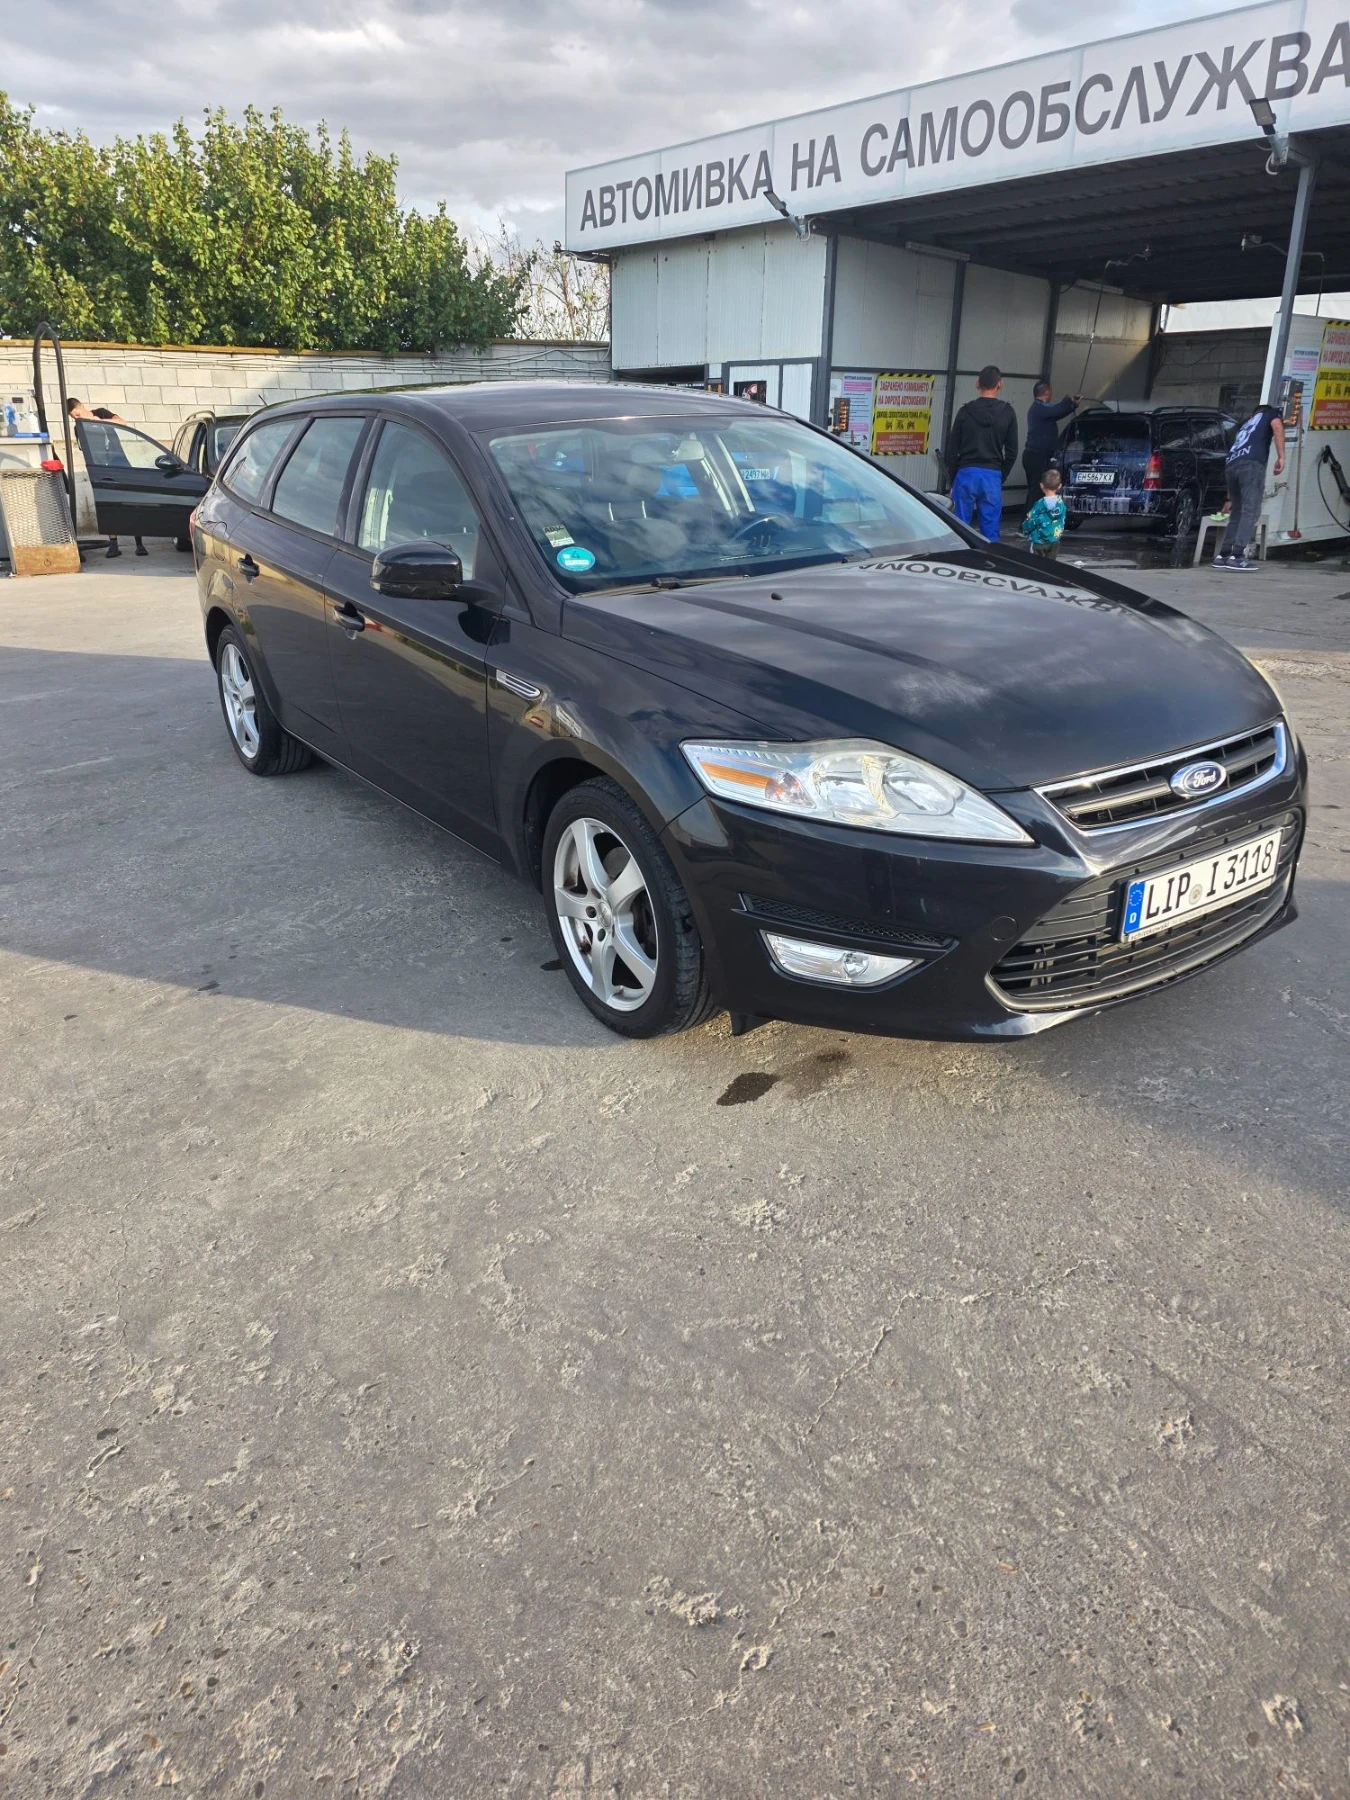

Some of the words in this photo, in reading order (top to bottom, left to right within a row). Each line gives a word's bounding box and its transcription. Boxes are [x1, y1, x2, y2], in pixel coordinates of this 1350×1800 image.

[580, 150, 773, 231] АВТОМИВКА
[791, 134, 842, 192] НА
[1193, 769, 1217, 788] Ford
[1129, 912, 1137, 924] D
[1146, 872, 1191, 920] LIP
[1206, 861, 1220, 897] I
[1224, 840, 1274, 889] 3118
